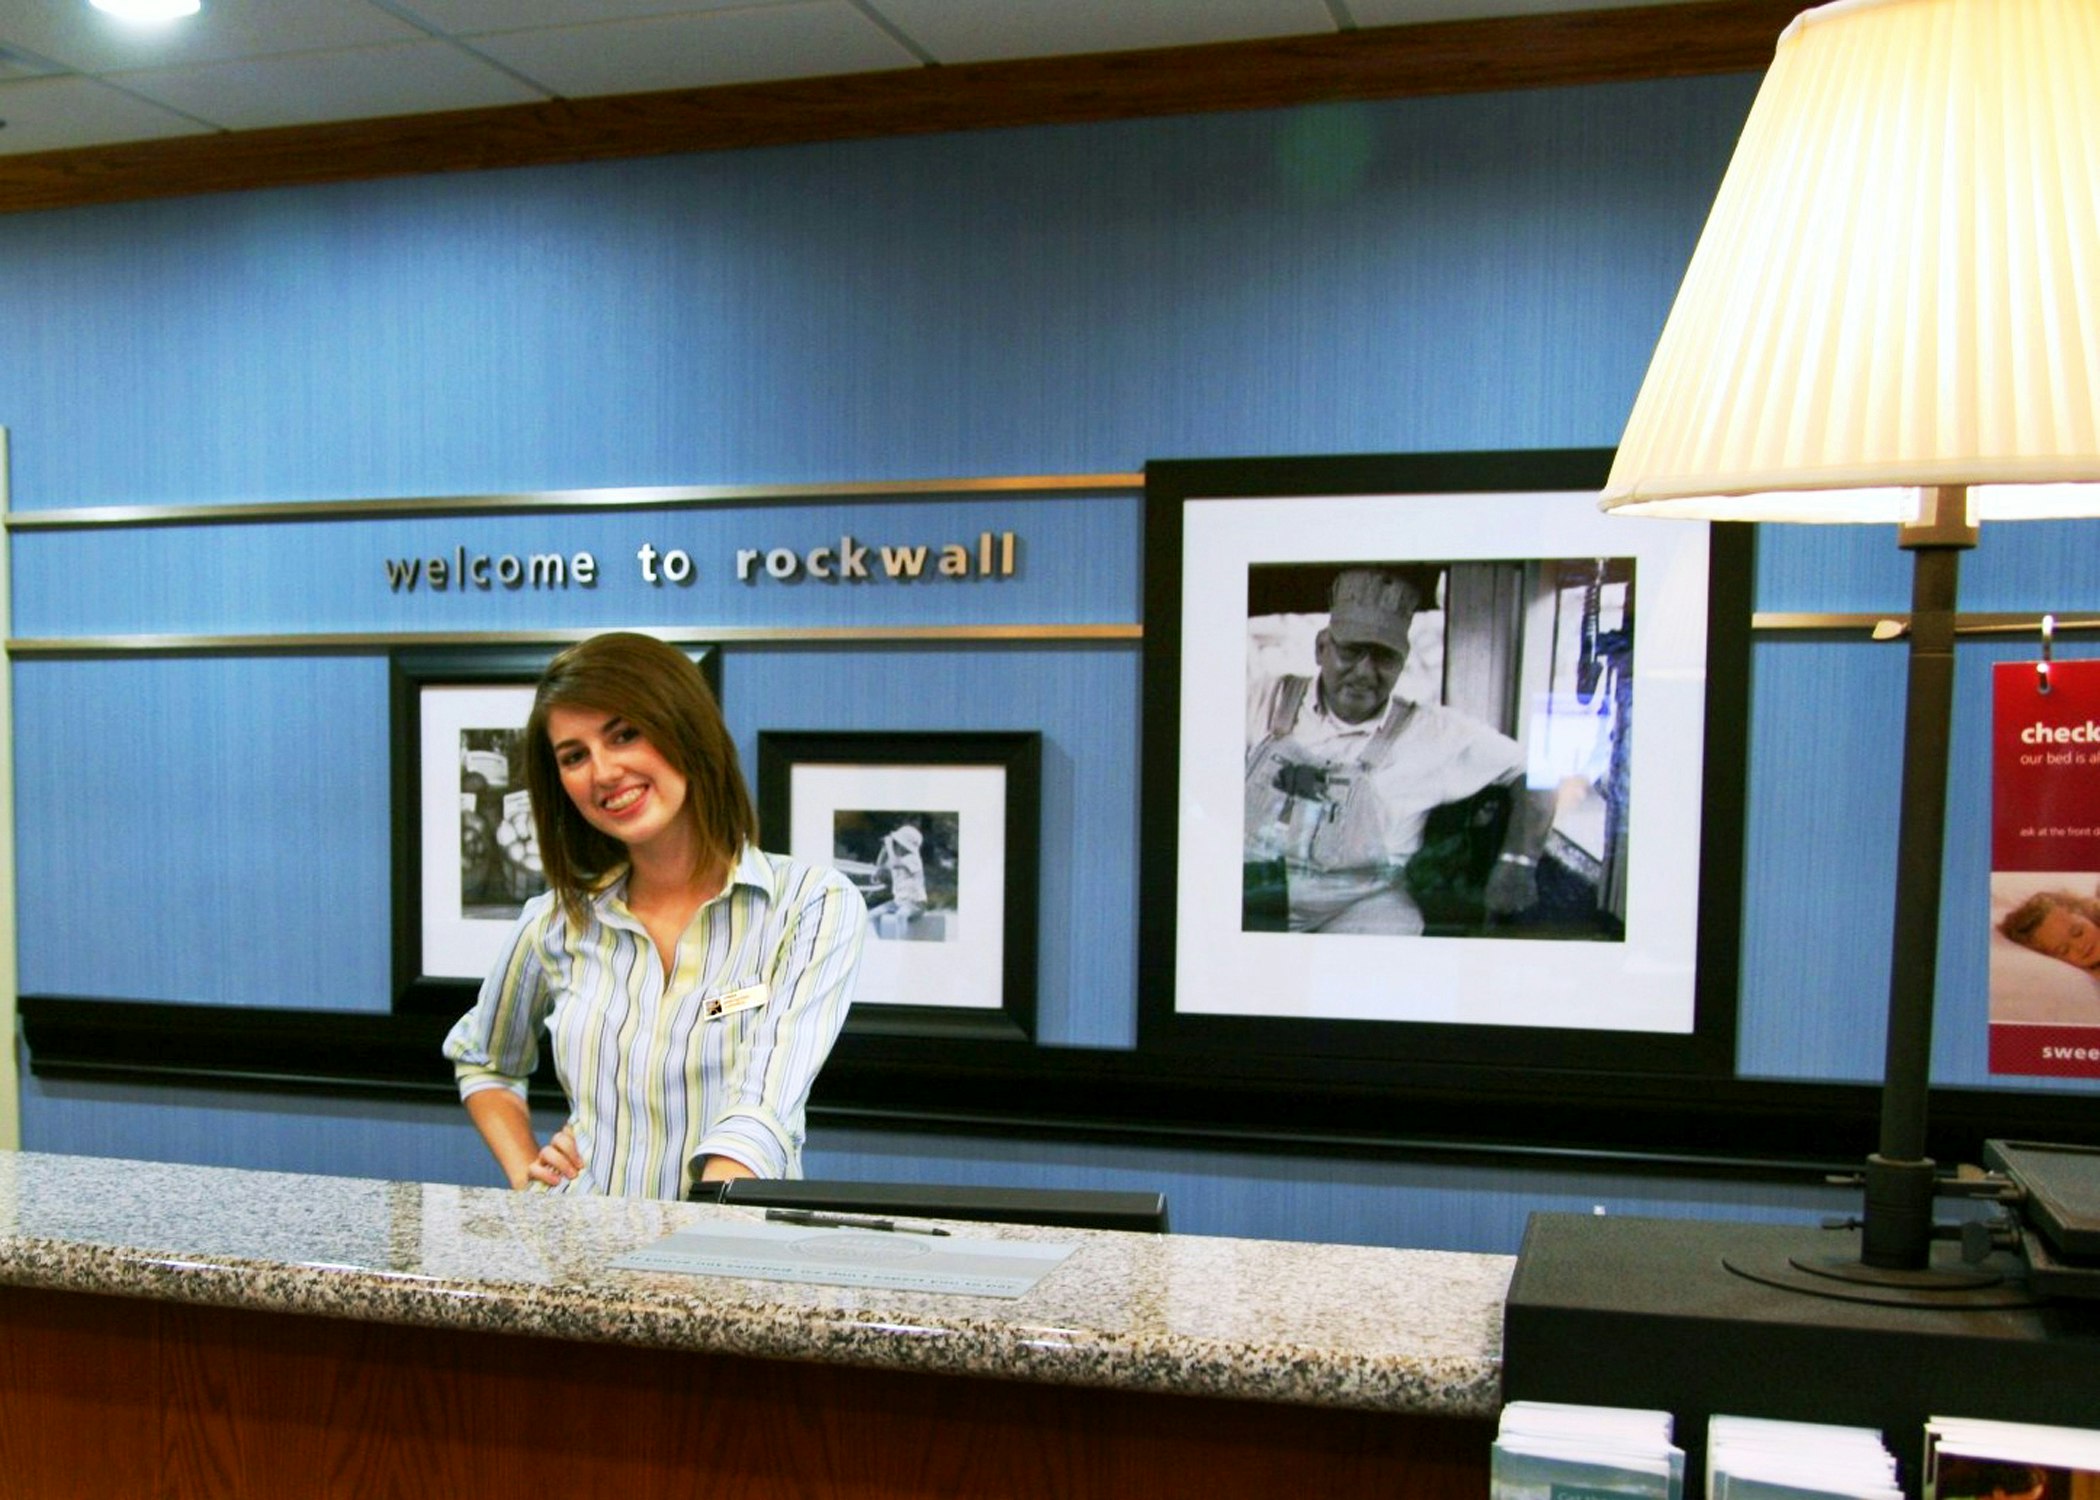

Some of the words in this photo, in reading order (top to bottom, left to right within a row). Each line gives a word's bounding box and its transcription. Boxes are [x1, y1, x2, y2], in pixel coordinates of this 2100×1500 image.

[386, 545, 595, 588] welcome
[637, 543, 691, 582] to
[736, 531, 1014, 580] rockwall
[2020, 753, 2043, 766] our
[2047, 751, 2072, 765] bed
[2076, 751, 2086, 765] is
[2020, 826, 2035, 837] ask
[2038, 826, 2047, 837] at
[2050, 826, 2066, 837] the
[2068, 826, 2091, 837] front
[2042, 1046, 2100, 1060] swee
